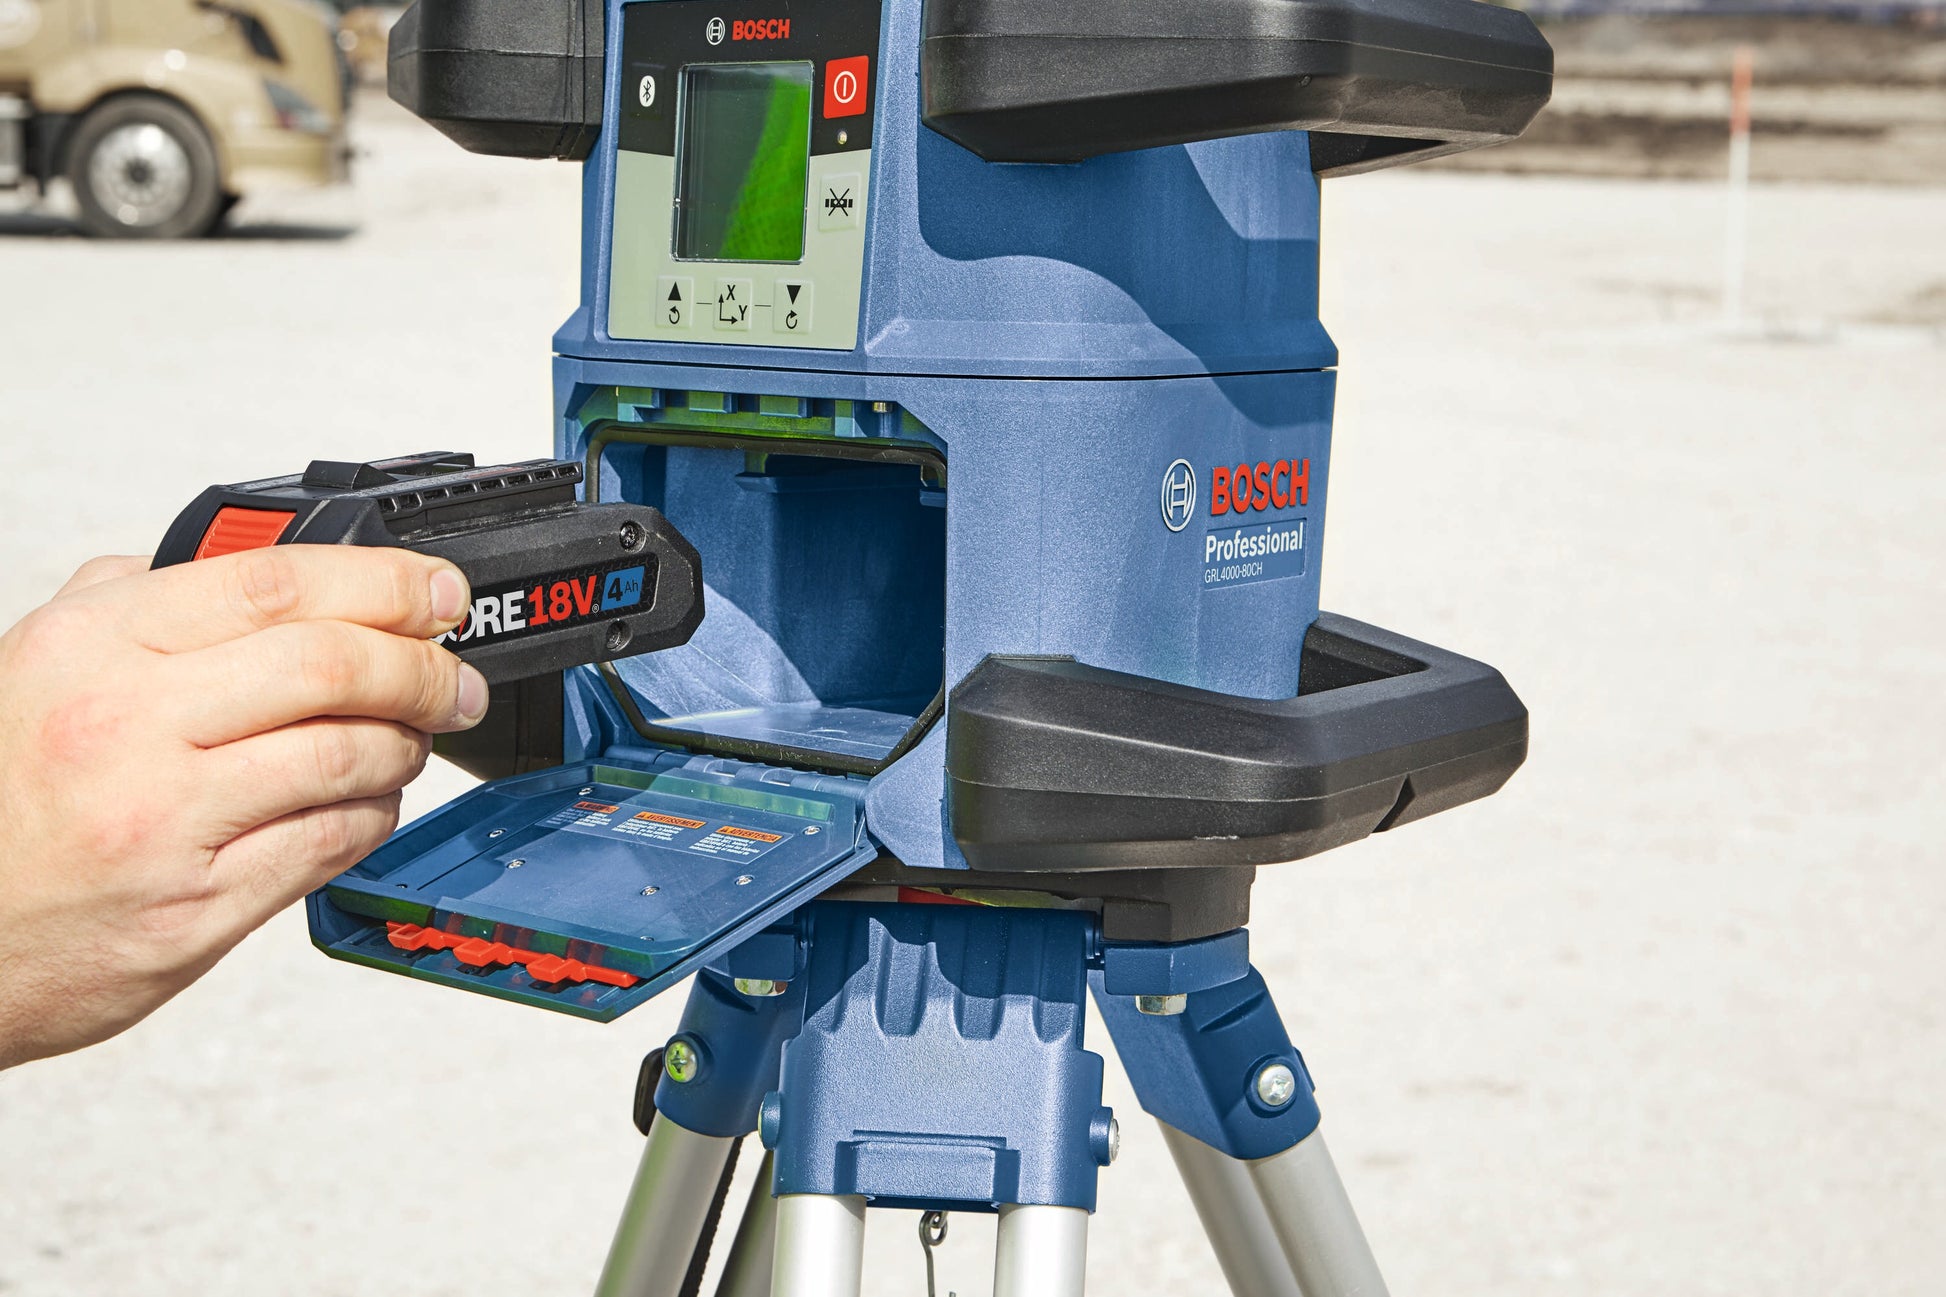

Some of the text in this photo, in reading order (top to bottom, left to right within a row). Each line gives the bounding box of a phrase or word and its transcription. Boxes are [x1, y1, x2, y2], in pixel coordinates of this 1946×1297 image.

[732, 18, 790, 41] BOSCH
[726, 285, 736, 301] X
[738, 305, 748, 321] Y
[1211, 458, 1310, 515] BOSCH
[1205, 522, 1304, 563] Professional
[1204, 562, 1263, 584] GRL4000-80CH
